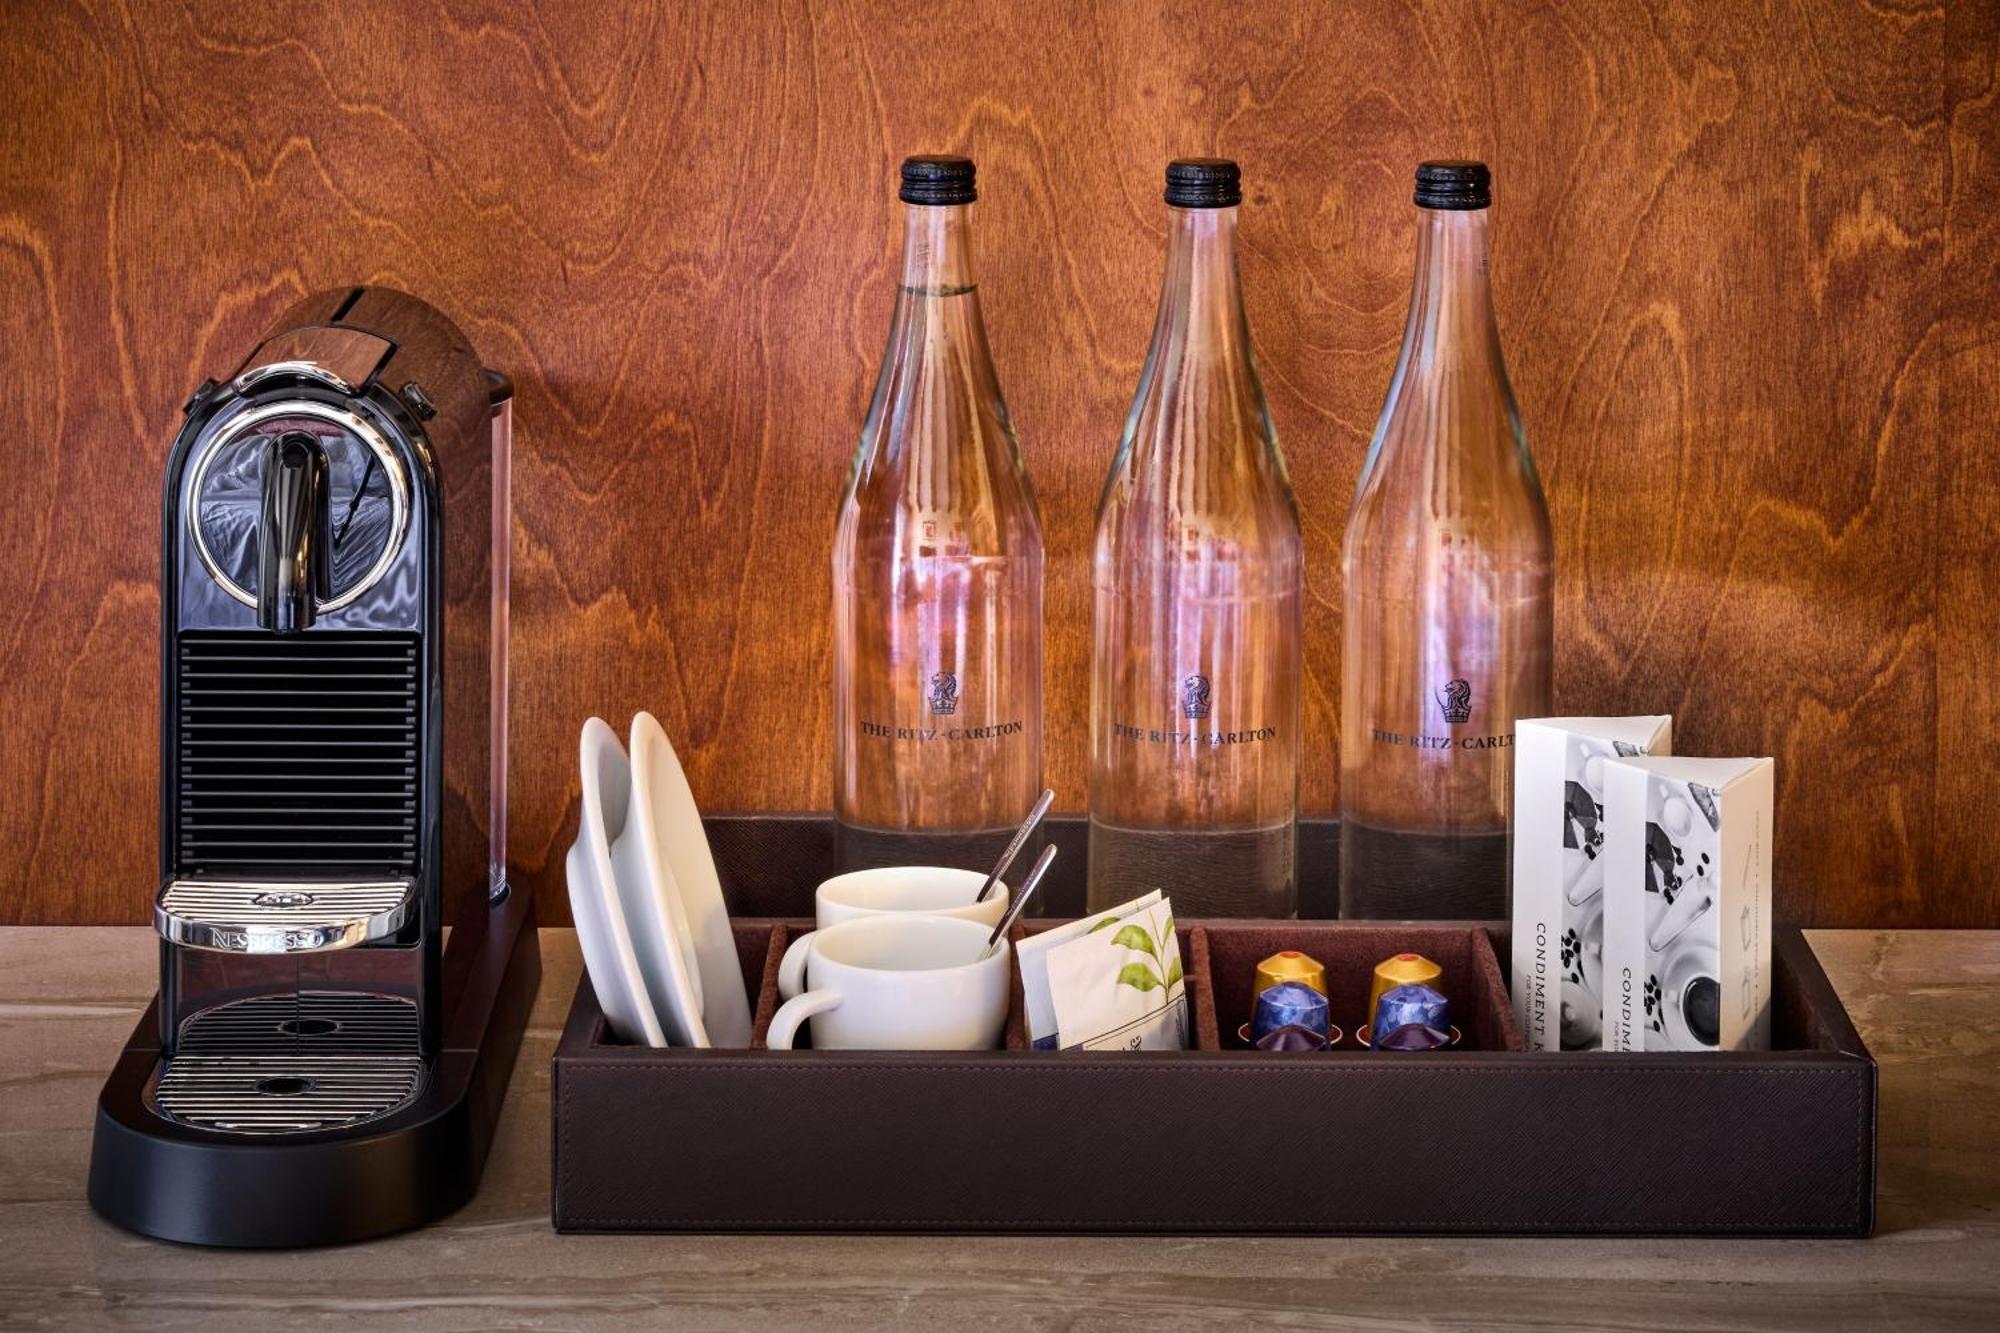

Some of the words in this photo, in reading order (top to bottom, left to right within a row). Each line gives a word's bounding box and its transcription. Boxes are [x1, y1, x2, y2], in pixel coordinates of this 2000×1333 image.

[860, 721, 892, 737] THE
[1113, 723, 1143, 740] THE
[1372, 729, 1403, 746] THE
[1410, 734, 1515, 750] RITZ-CARLT
[1535, 922, 1547, 1036] CONDIMENT
